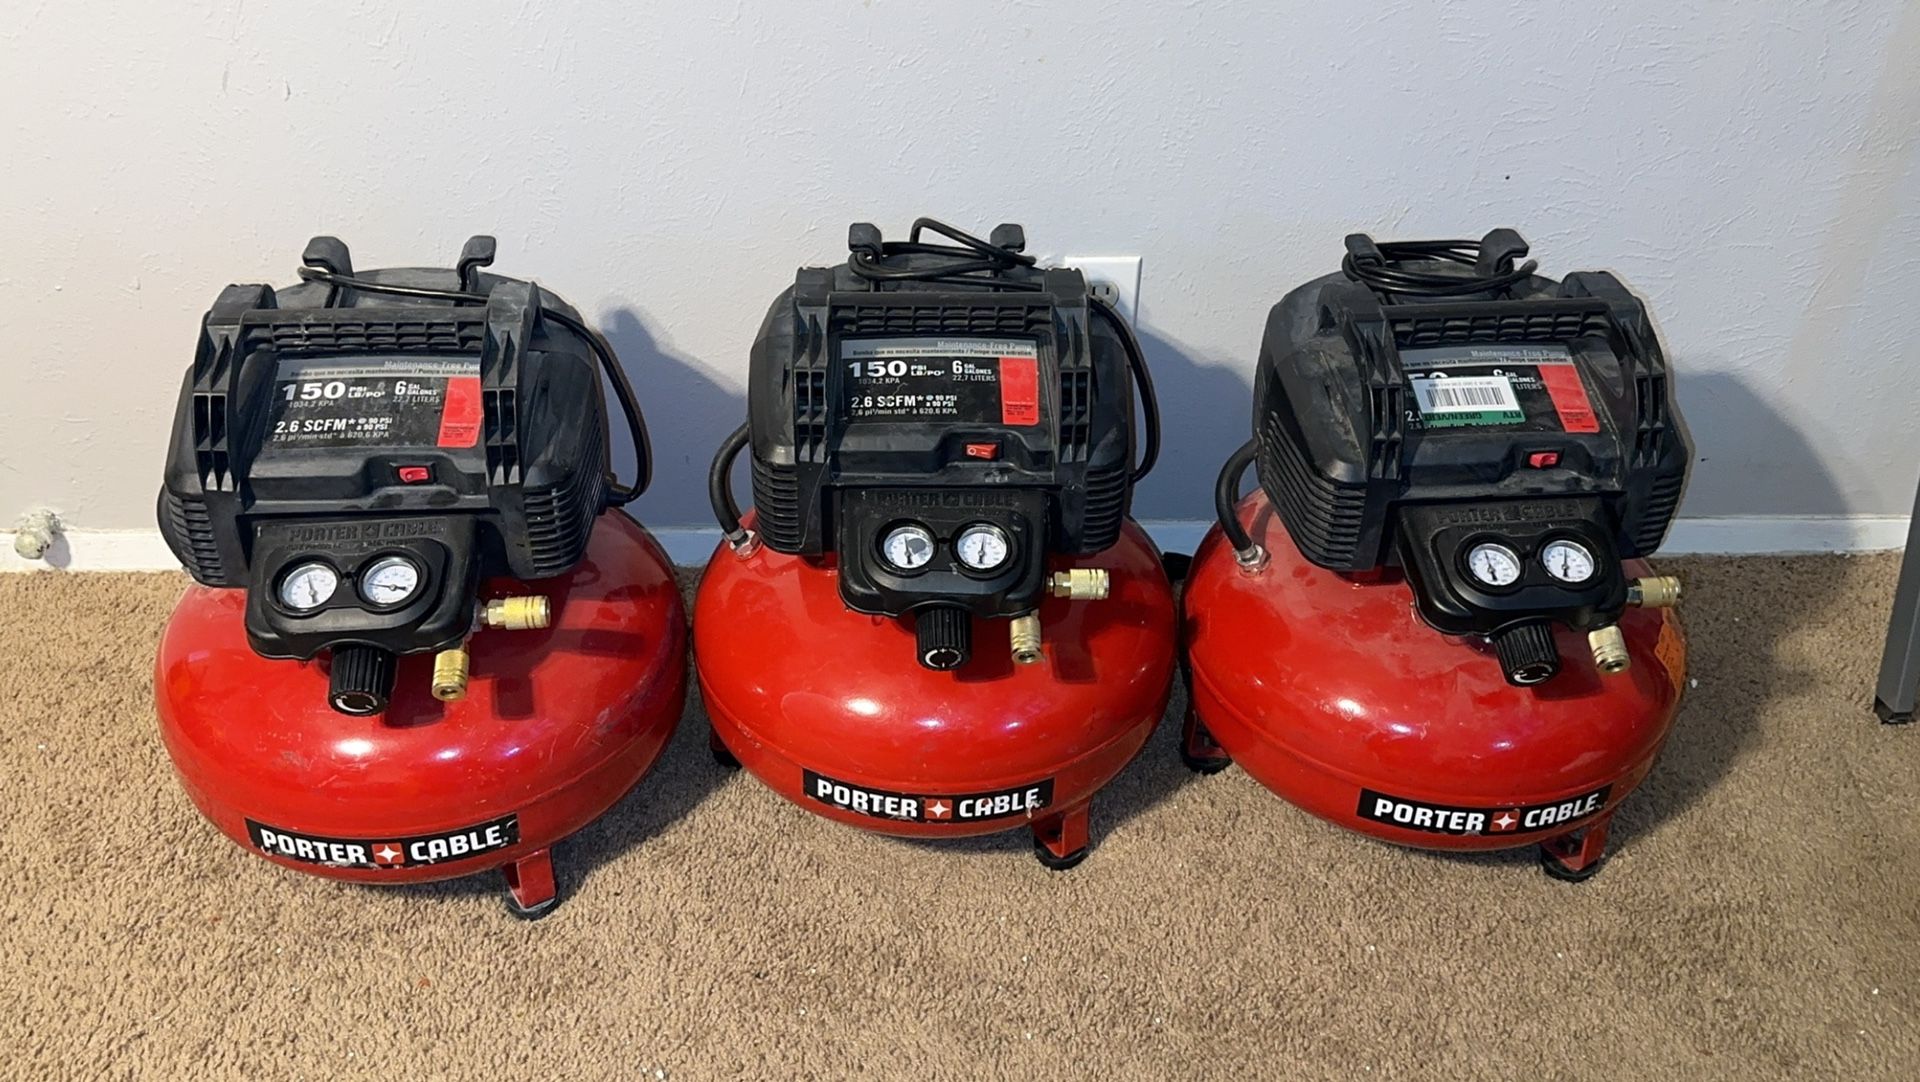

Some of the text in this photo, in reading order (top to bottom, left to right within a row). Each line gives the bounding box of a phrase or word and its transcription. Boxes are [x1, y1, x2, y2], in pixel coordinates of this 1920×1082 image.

[848, 360, 908, 377] 150
[952, 360, 963, 374] 6
[282, 381, 347, 400] 150
[394, 381, 407, 395] 6
[412, 395, 440, 403] LITERS
[851, 396, 873, 408] 2.6
[274, 420, 300, 433] 2.6
[290, 525, 357, 541] PORTER
[817, 778, 1040, 818] PORTER CABLE
[1374, 793, 1600, 831] PORTER CABLE
[260, 825, 503, 864] PORTER CABLE
